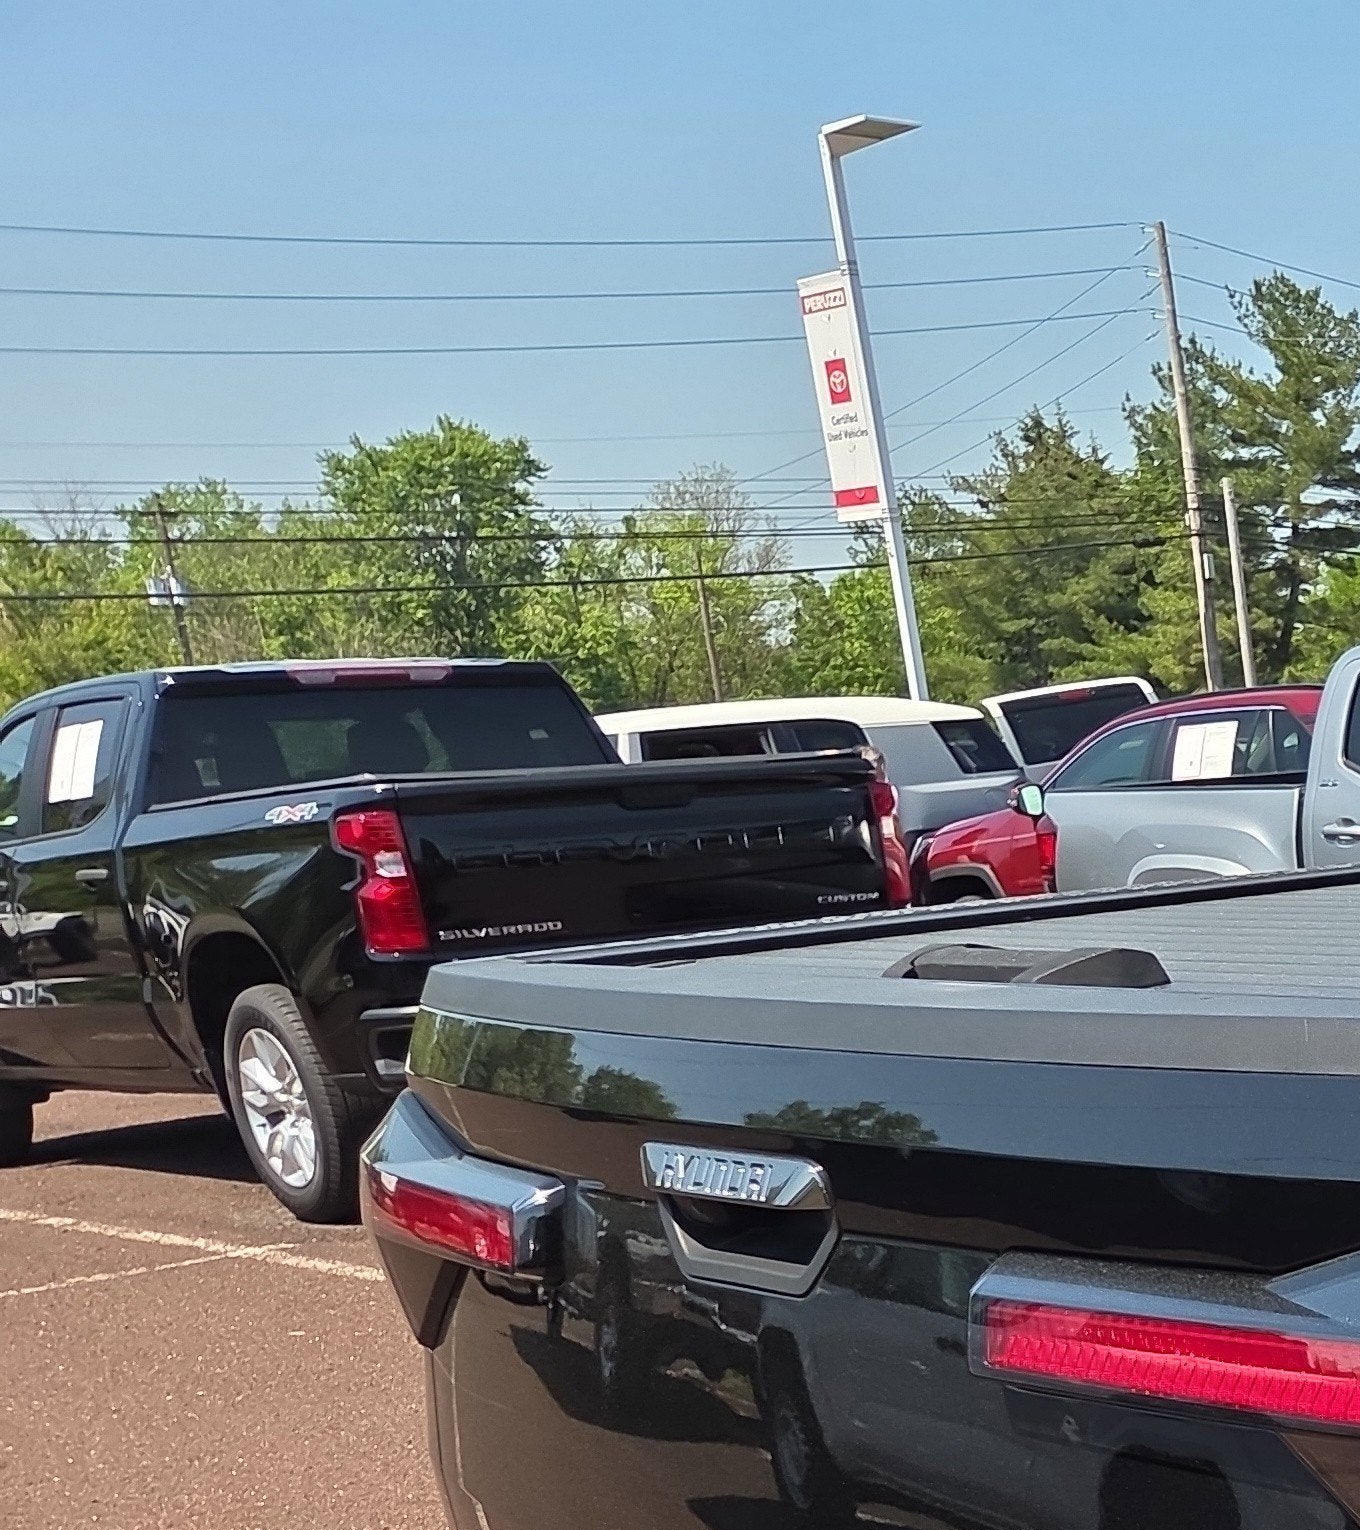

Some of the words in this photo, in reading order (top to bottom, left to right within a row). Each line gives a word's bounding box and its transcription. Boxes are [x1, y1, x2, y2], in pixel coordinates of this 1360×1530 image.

[817, 891, 880, 904] CUSTOM
[438, 921, 563, 941] SILVERADO
[655, 1150, 775, 1203] HYUNDAI
